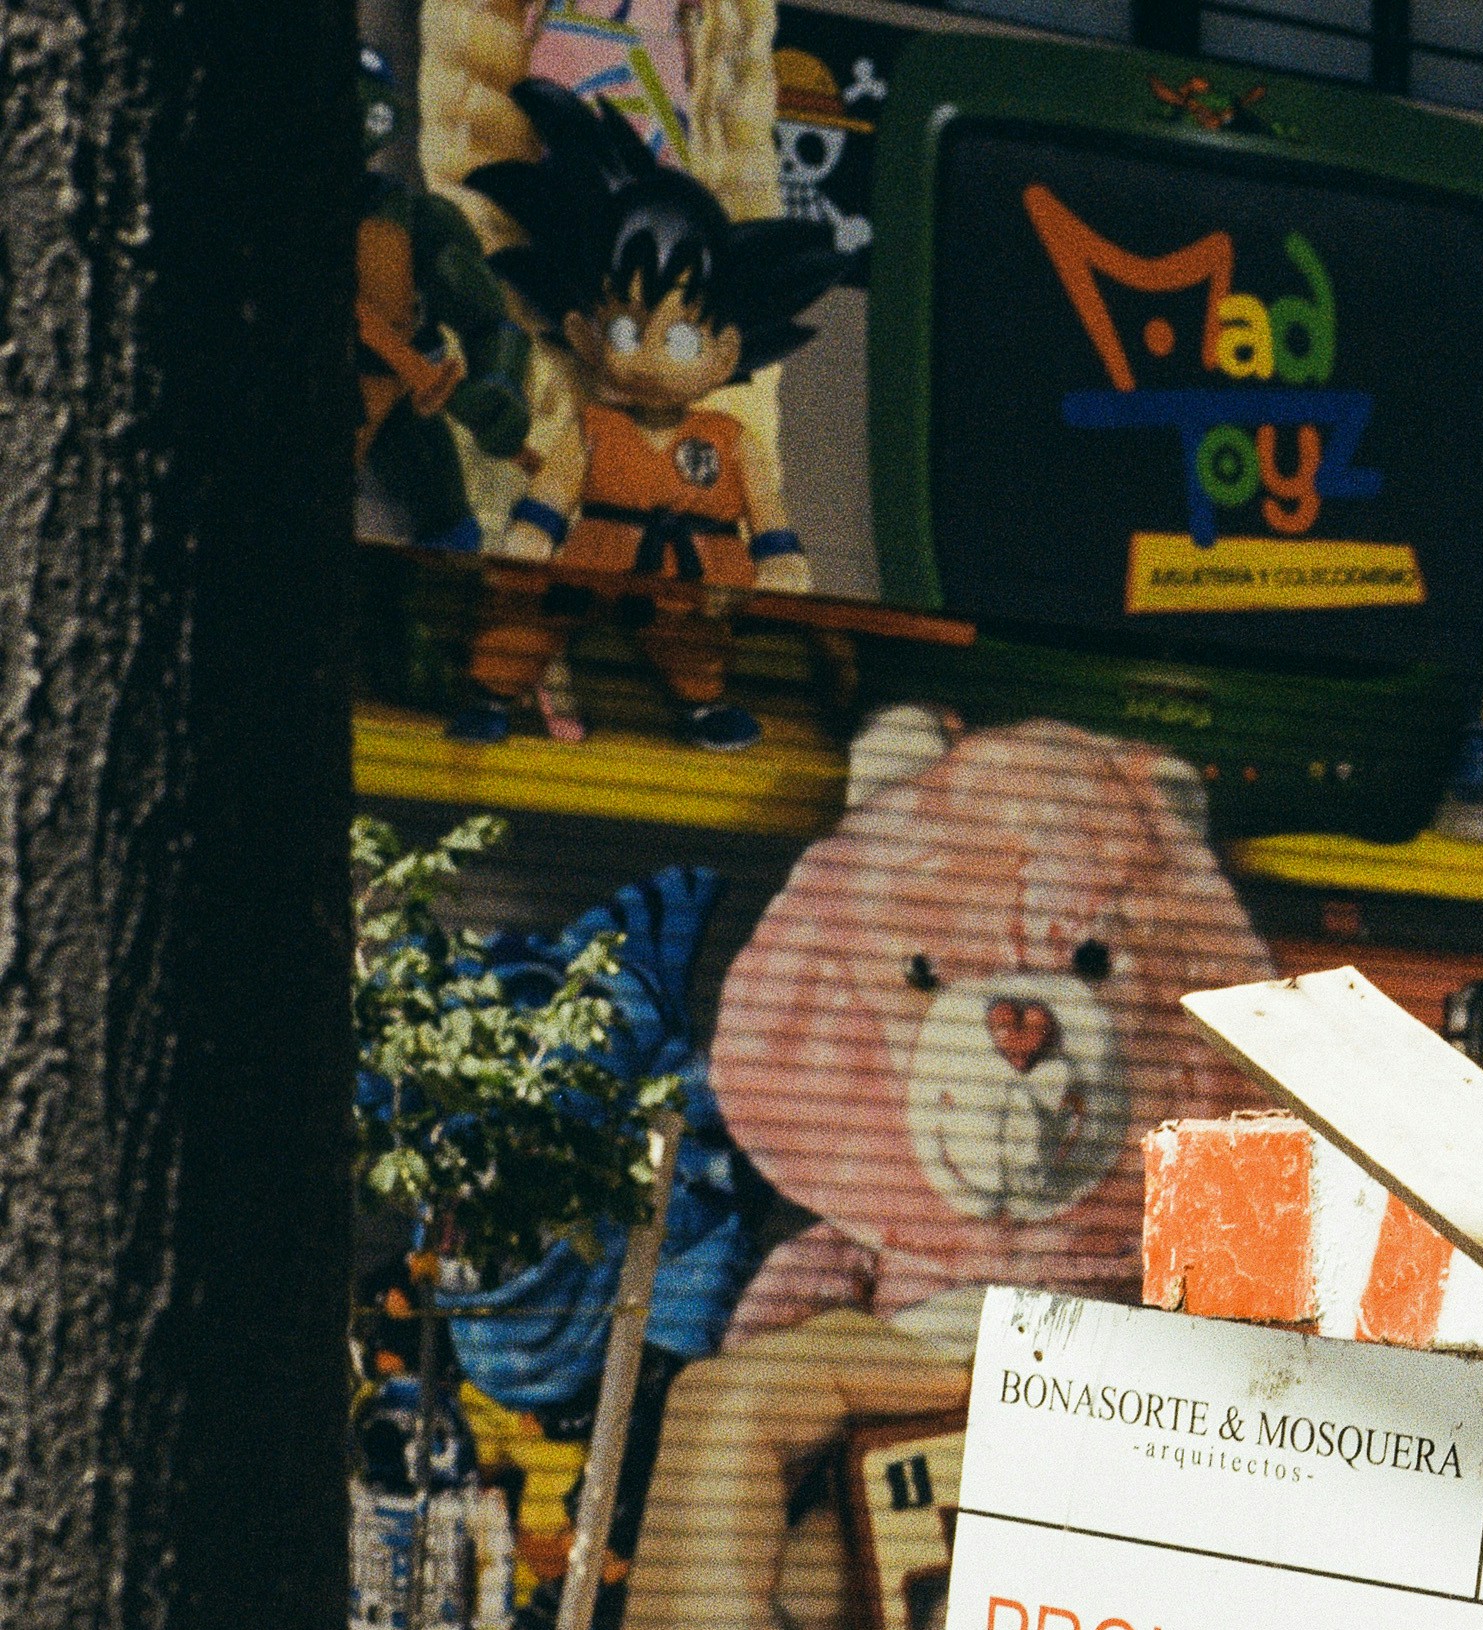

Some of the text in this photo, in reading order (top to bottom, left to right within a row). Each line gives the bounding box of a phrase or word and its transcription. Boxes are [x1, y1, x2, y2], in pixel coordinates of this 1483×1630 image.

[1022, 182, 1336, 393] Mad
[1000, 1369, 1464, 1479] BONASORTE & MOSQUERA
